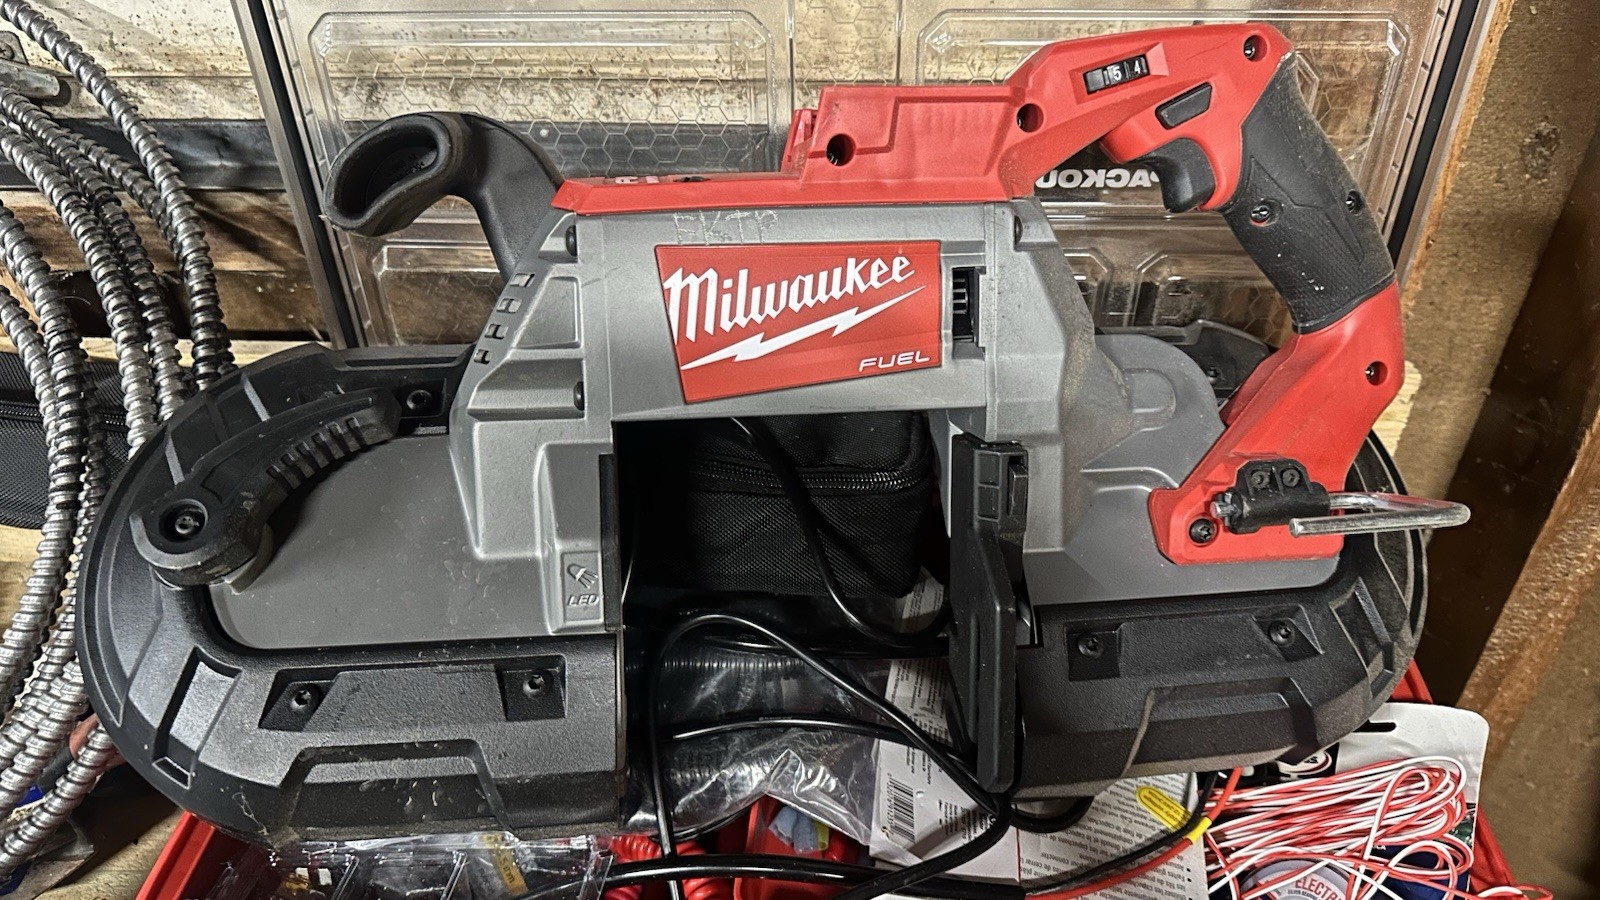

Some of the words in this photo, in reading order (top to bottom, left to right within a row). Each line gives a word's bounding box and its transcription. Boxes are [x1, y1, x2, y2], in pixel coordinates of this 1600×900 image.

[1134, 60, 1141, 74] 4
[663, 255, 915, 345] Milwaukee
[859, 350, 931, 372] FUEL
[567, 594, 599, 606] LED
